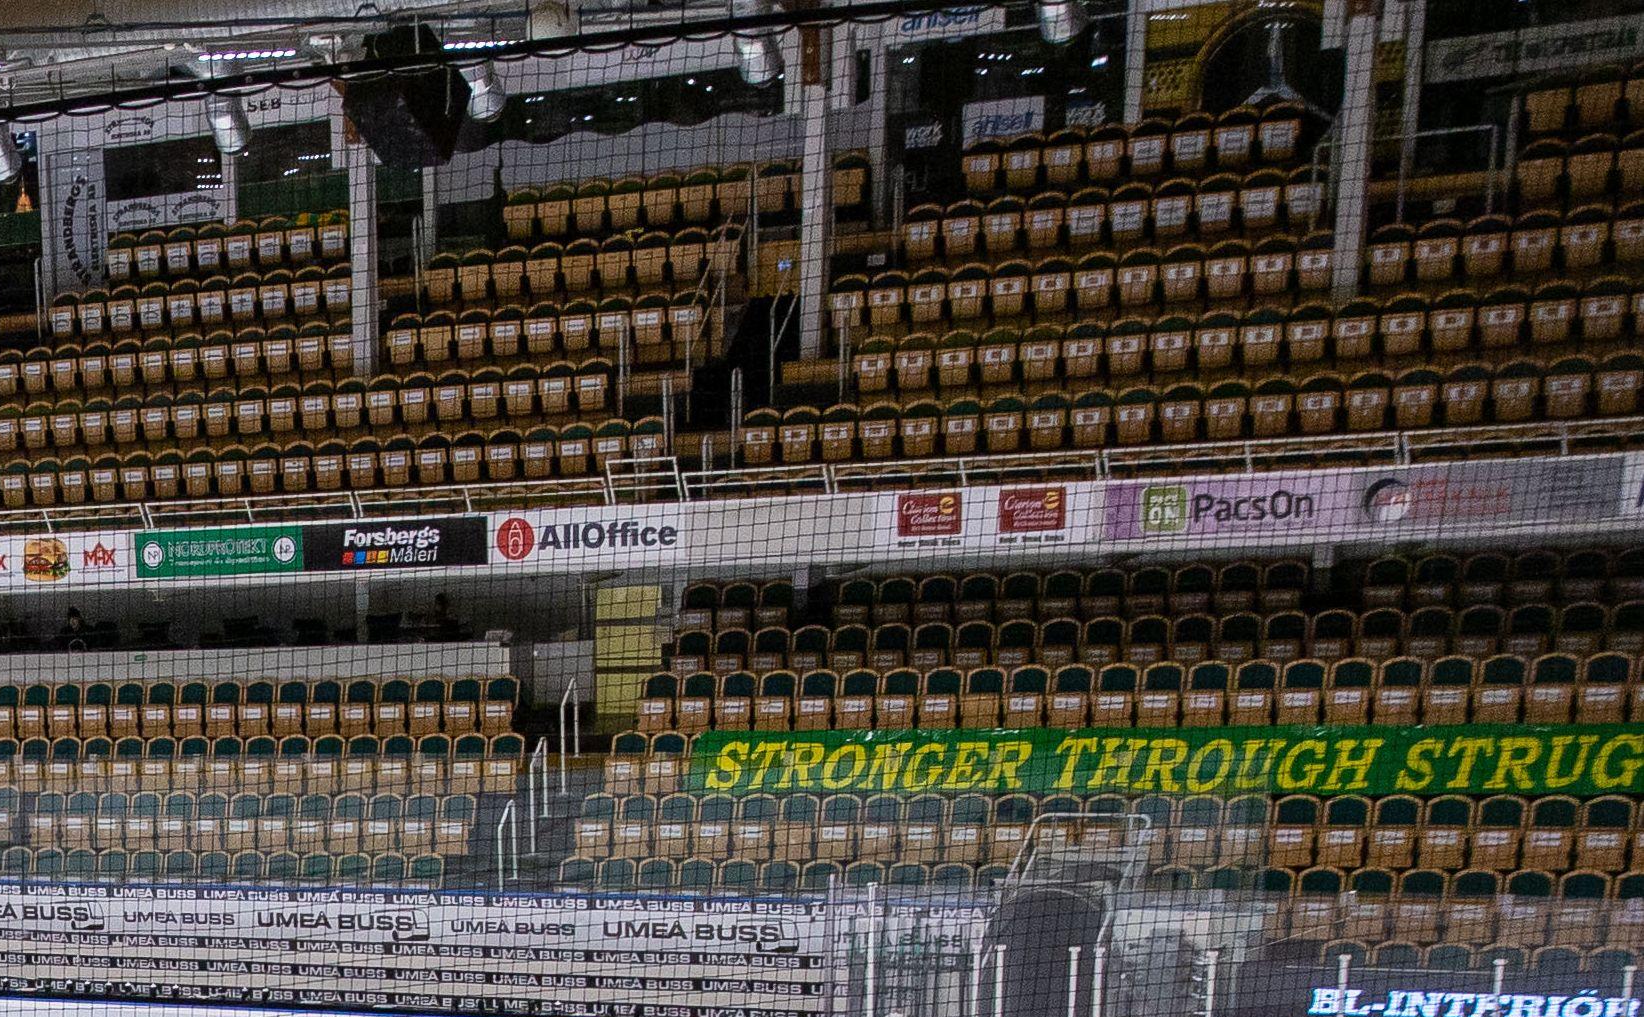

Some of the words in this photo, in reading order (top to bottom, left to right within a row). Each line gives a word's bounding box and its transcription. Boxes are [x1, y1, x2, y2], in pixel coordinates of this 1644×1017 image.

[1193, 490, 1315, 525] PacsOn
[344, 527, 441, 550] Forsbergs
[538, 520, 678, 551] AllOffice
[389, 547, 438, 566] Måleri
[704, 736, 1033, 792] STRONGER
[1052, 735, 1386, 794] THROUGH
[22, 904, 94, 922] BUSS
[123, 908, 179, 926] UMEÅ
[181, 911, 235, 926] BUSS
[256, 909, 332, 932] UMEÅ
[336, 913, 414, 934] BUSS
[450, 918, 510, 936] UMEÅ
[514, 922, 576, 937] BUSS
[604, 919, 691, 942] UMEÅ
[695, 922, 780, 945] BUSS
